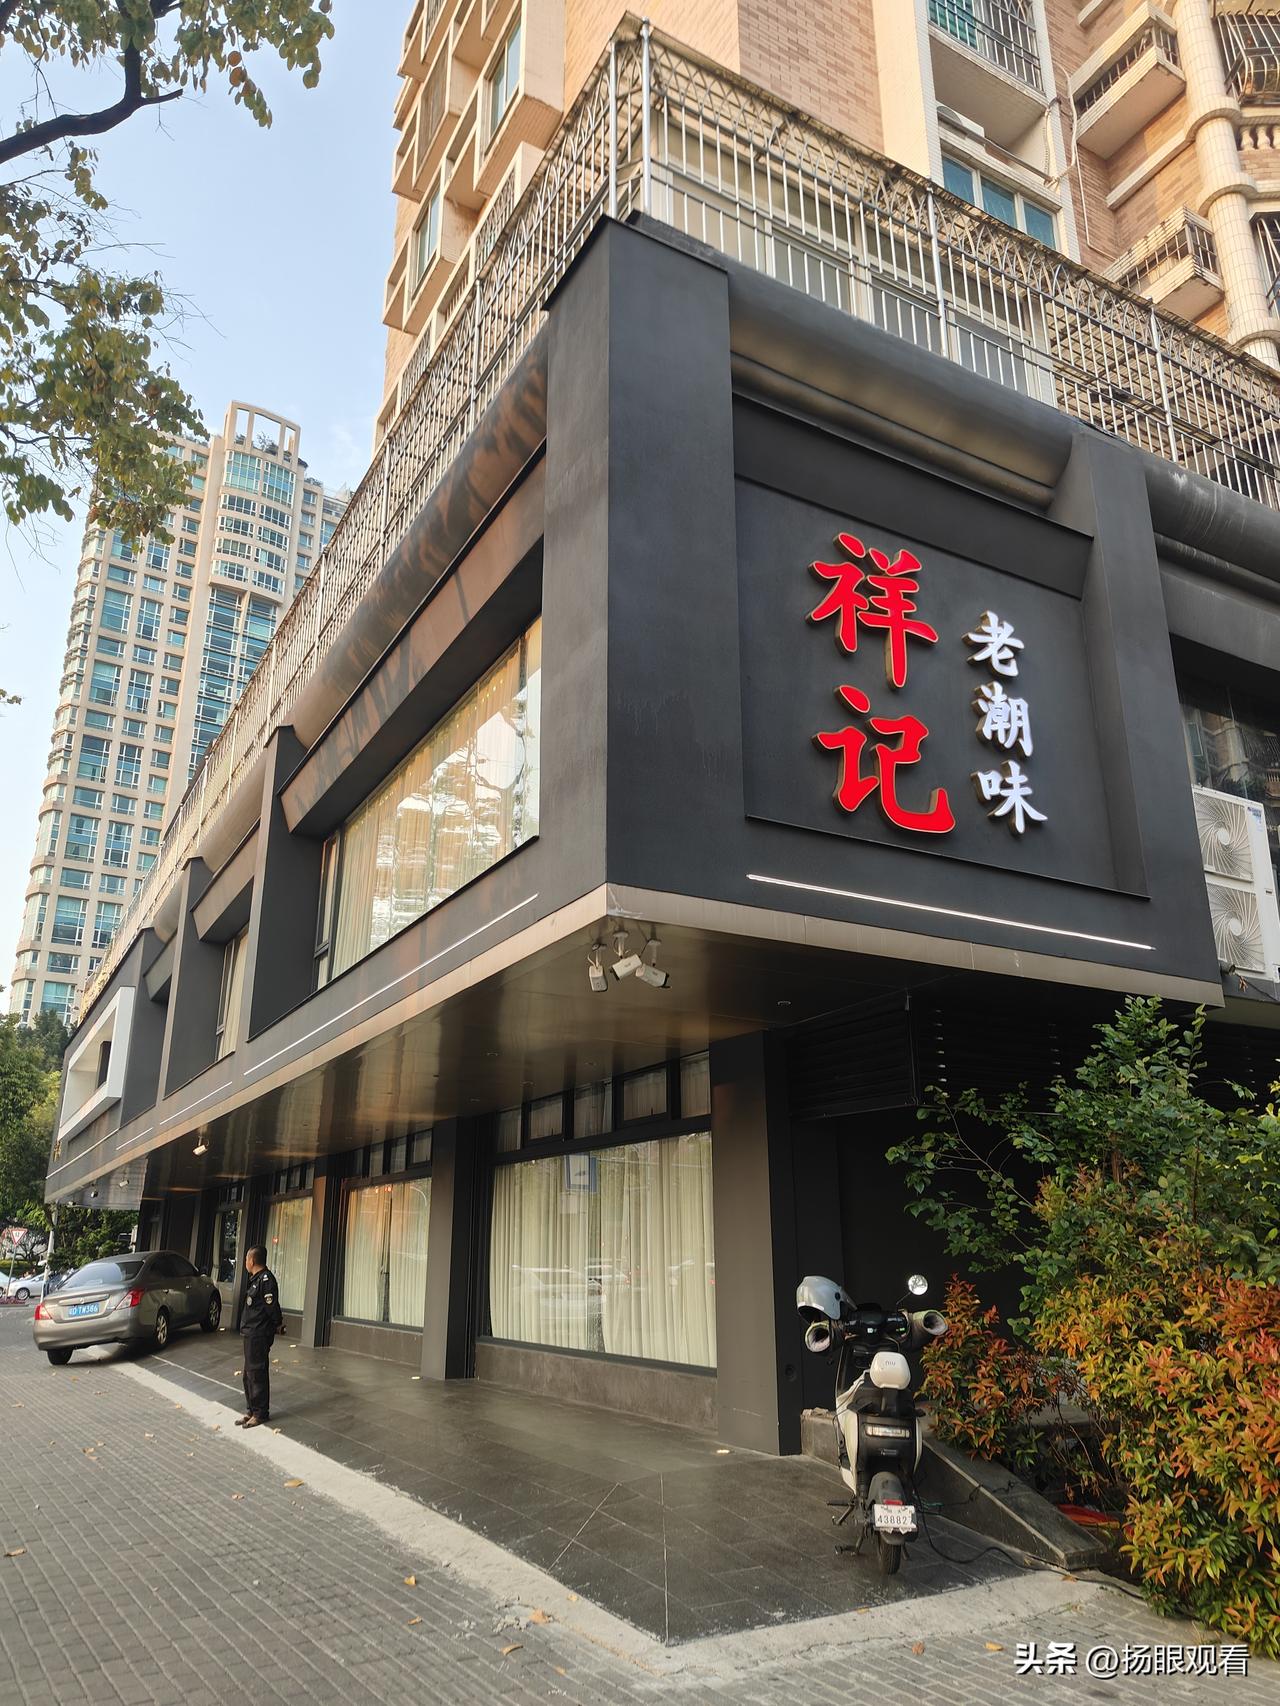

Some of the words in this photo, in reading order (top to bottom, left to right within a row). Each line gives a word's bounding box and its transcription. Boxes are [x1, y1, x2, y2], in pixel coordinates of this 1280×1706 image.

[807, 532, 956, 834] 祥记
[963, 610, 1048, 834] 老潮味
